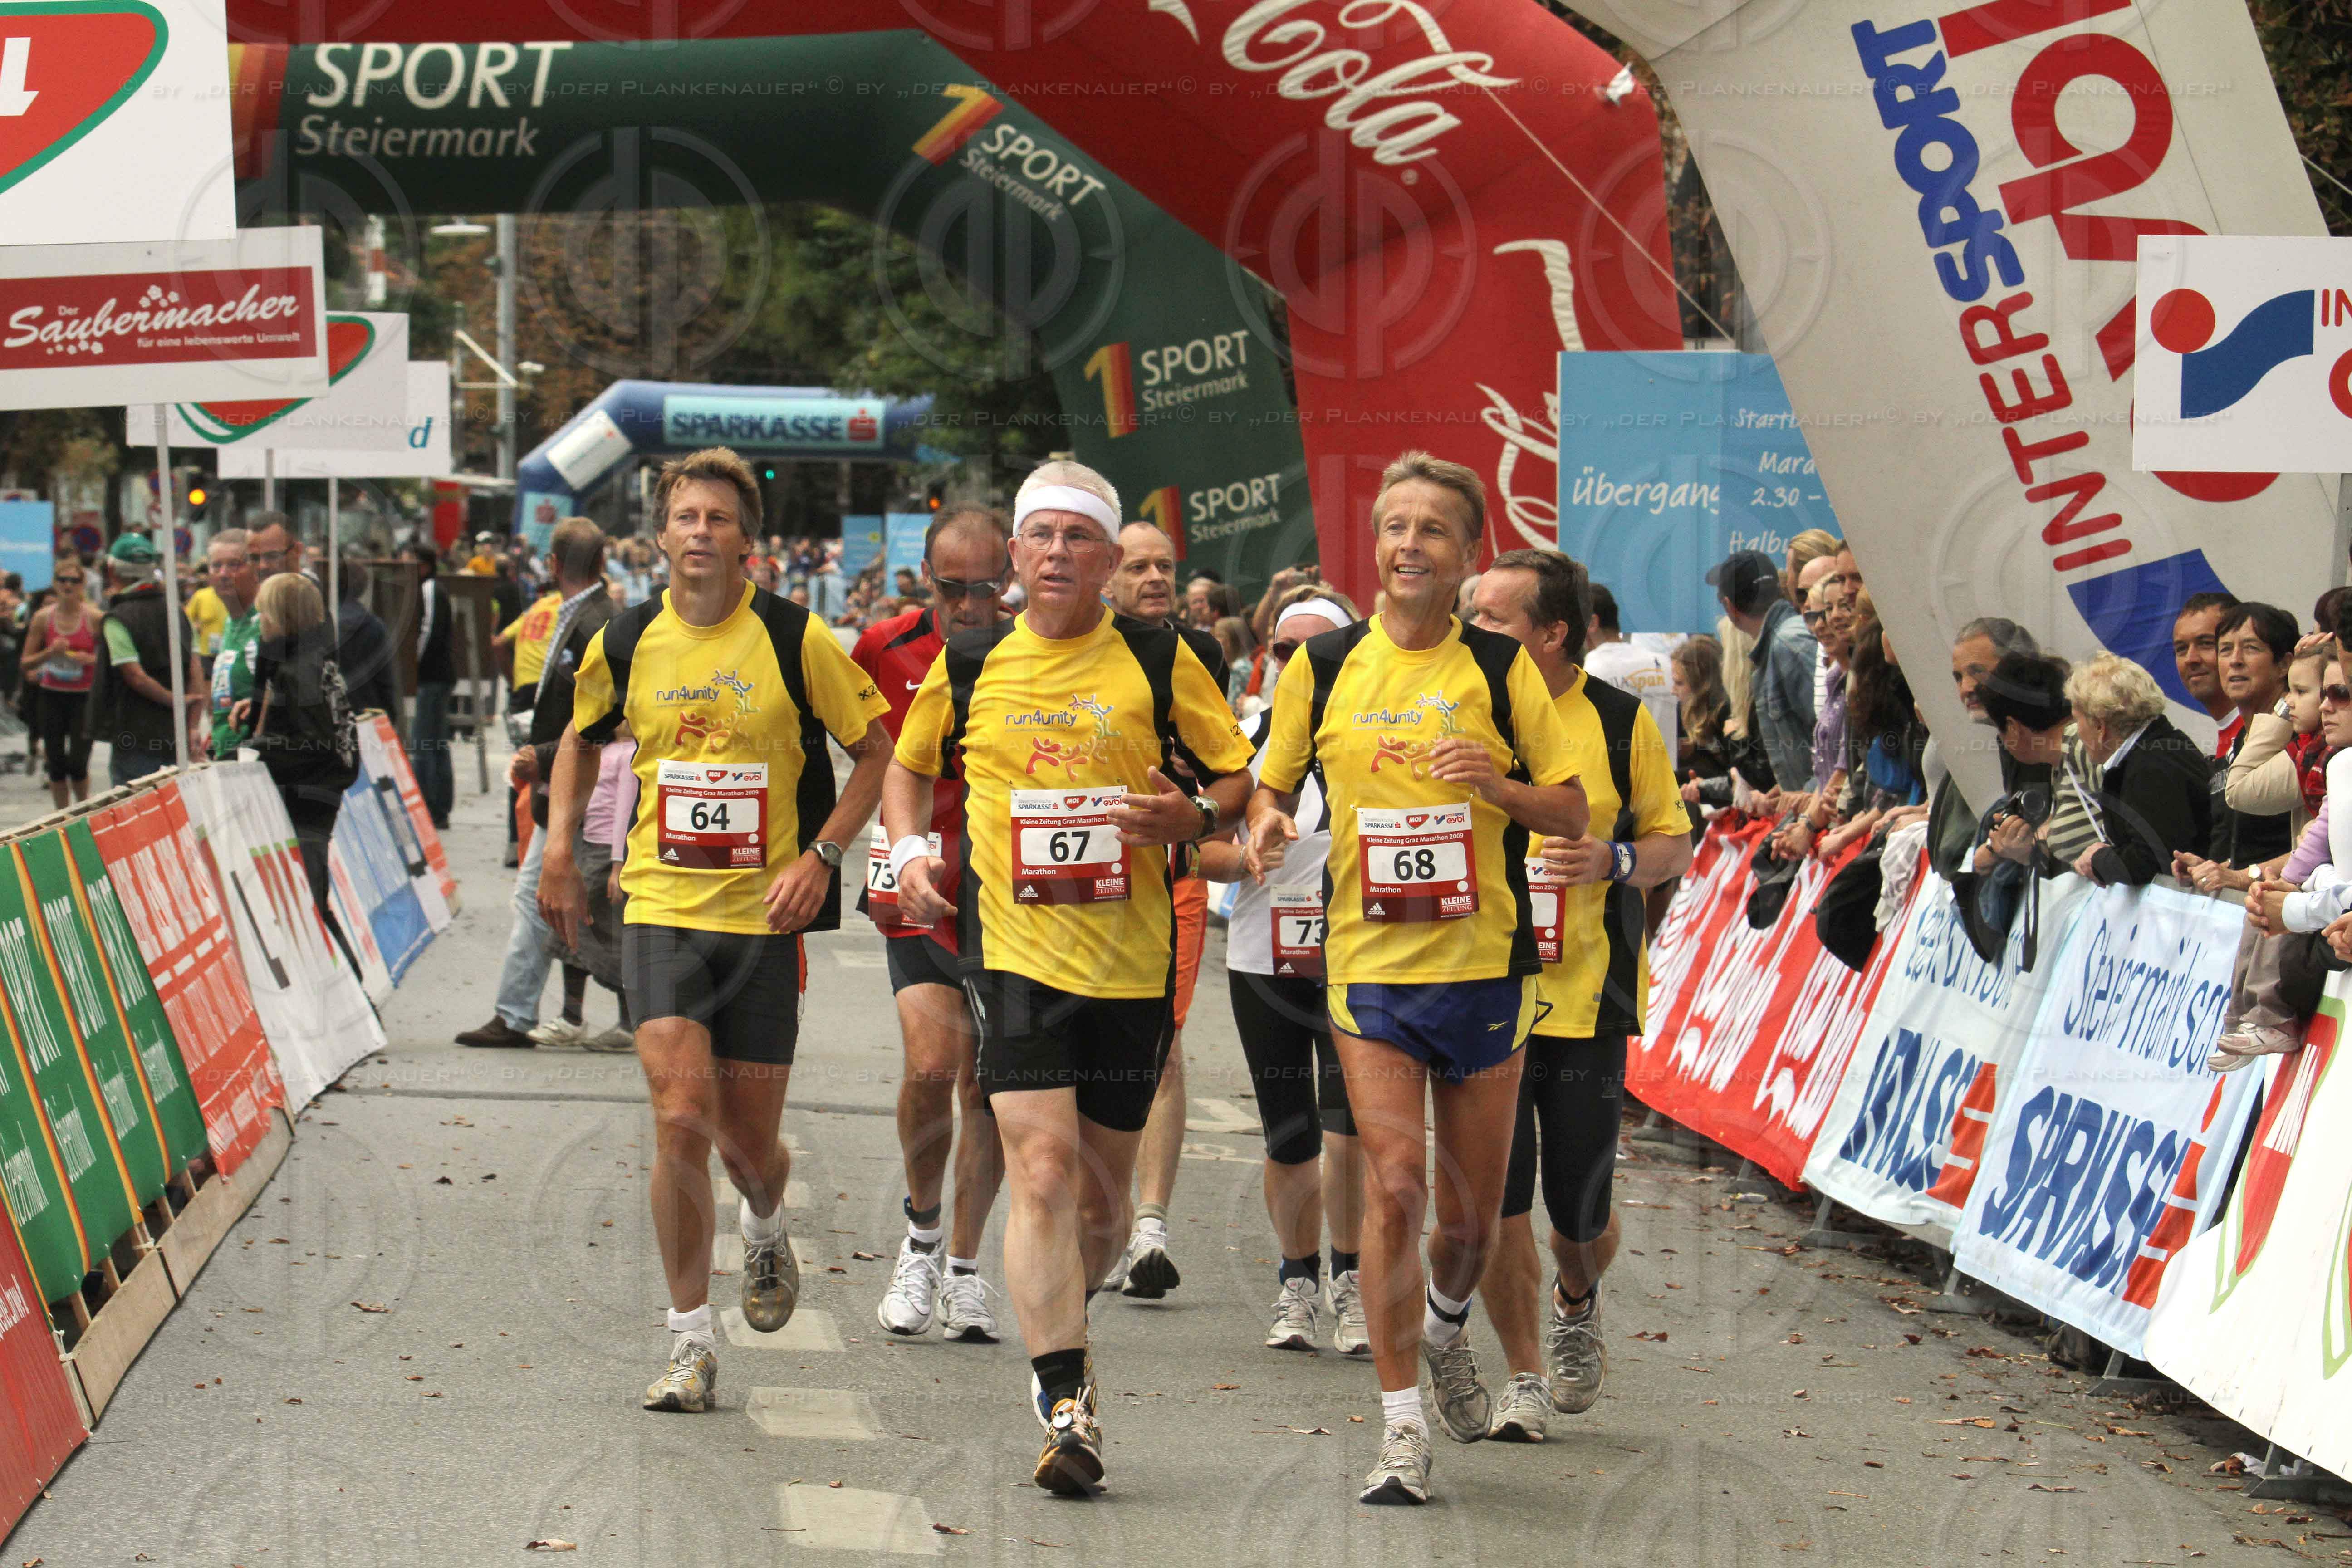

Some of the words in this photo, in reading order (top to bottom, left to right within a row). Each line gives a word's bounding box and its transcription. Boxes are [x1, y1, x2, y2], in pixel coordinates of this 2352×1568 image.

[307, 41, 573, 109] SPORT
[296, 114, 540, 157] Steiermark
[981, 123, 1105, 206] SPORT
[960, 147, 1066, 222] Steiermark
[1851, 18, 2133, 573] INTERSPORT
[3, 284, 299, 348] Saubermacher
[58, 304, 78, 316] Der
[137, 337, 154, 348] für
[157, 338, 181, 348] eine
[184, 333, 254, 347] lebenswerte
[256, 331, 301, 343] Umwelt
[1141, 329, 1250, 386] SPORT
[1142, 369, 1250, 412] Steiermark
[671, 409, 843, 440] SPARKASSE
[1189, 472, 1281, 523] SPORT
[1750, 486, 1800, 507] 2.30
[1191, 507, 1281, 544] Steiermark
[657, 684, 720, 702] run4unity
[1005, 708, 1078, 726] run4unity
[1353, 709, 1423, 725] run4unity
[683, 788, 703, 796] Zeitung
[1103, 798, 1122, 806] eybl
[691, 801, 730, 831] 64
[1446, 816, 1465, 824] eybl
[666, 832, 696, 842] Marathon
[1049, 830, 1091, 862] 67
[732, 847, 761, 856] KLEINE
[1393, 849, 1436, 881] 68
[1096, 878, 1124, 887] KLEINE
[1441, 895, 1471, 906] KLEINE
[1441, 905, 1472, 913] ZEITUNG
[1539, 941, 1557, 950] EINE
